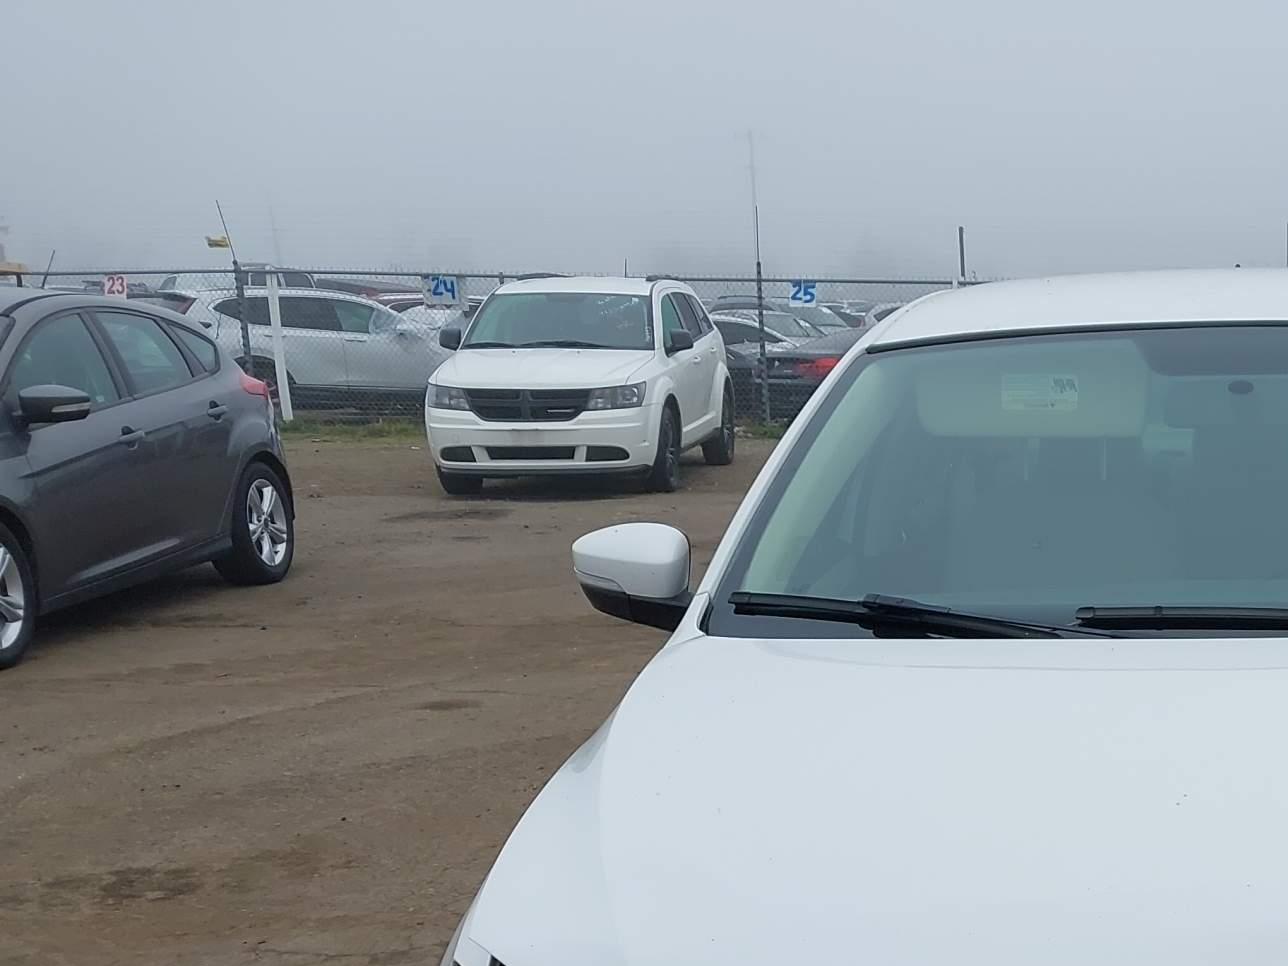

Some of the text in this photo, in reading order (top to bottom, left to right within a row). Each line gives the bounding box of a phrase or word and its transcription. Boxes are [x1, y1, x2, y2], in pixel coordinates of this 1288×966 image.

[107, 276, 125, 295] 23
[432, 277, 455, 299] 24
[791, 281, 815, 303] 25
